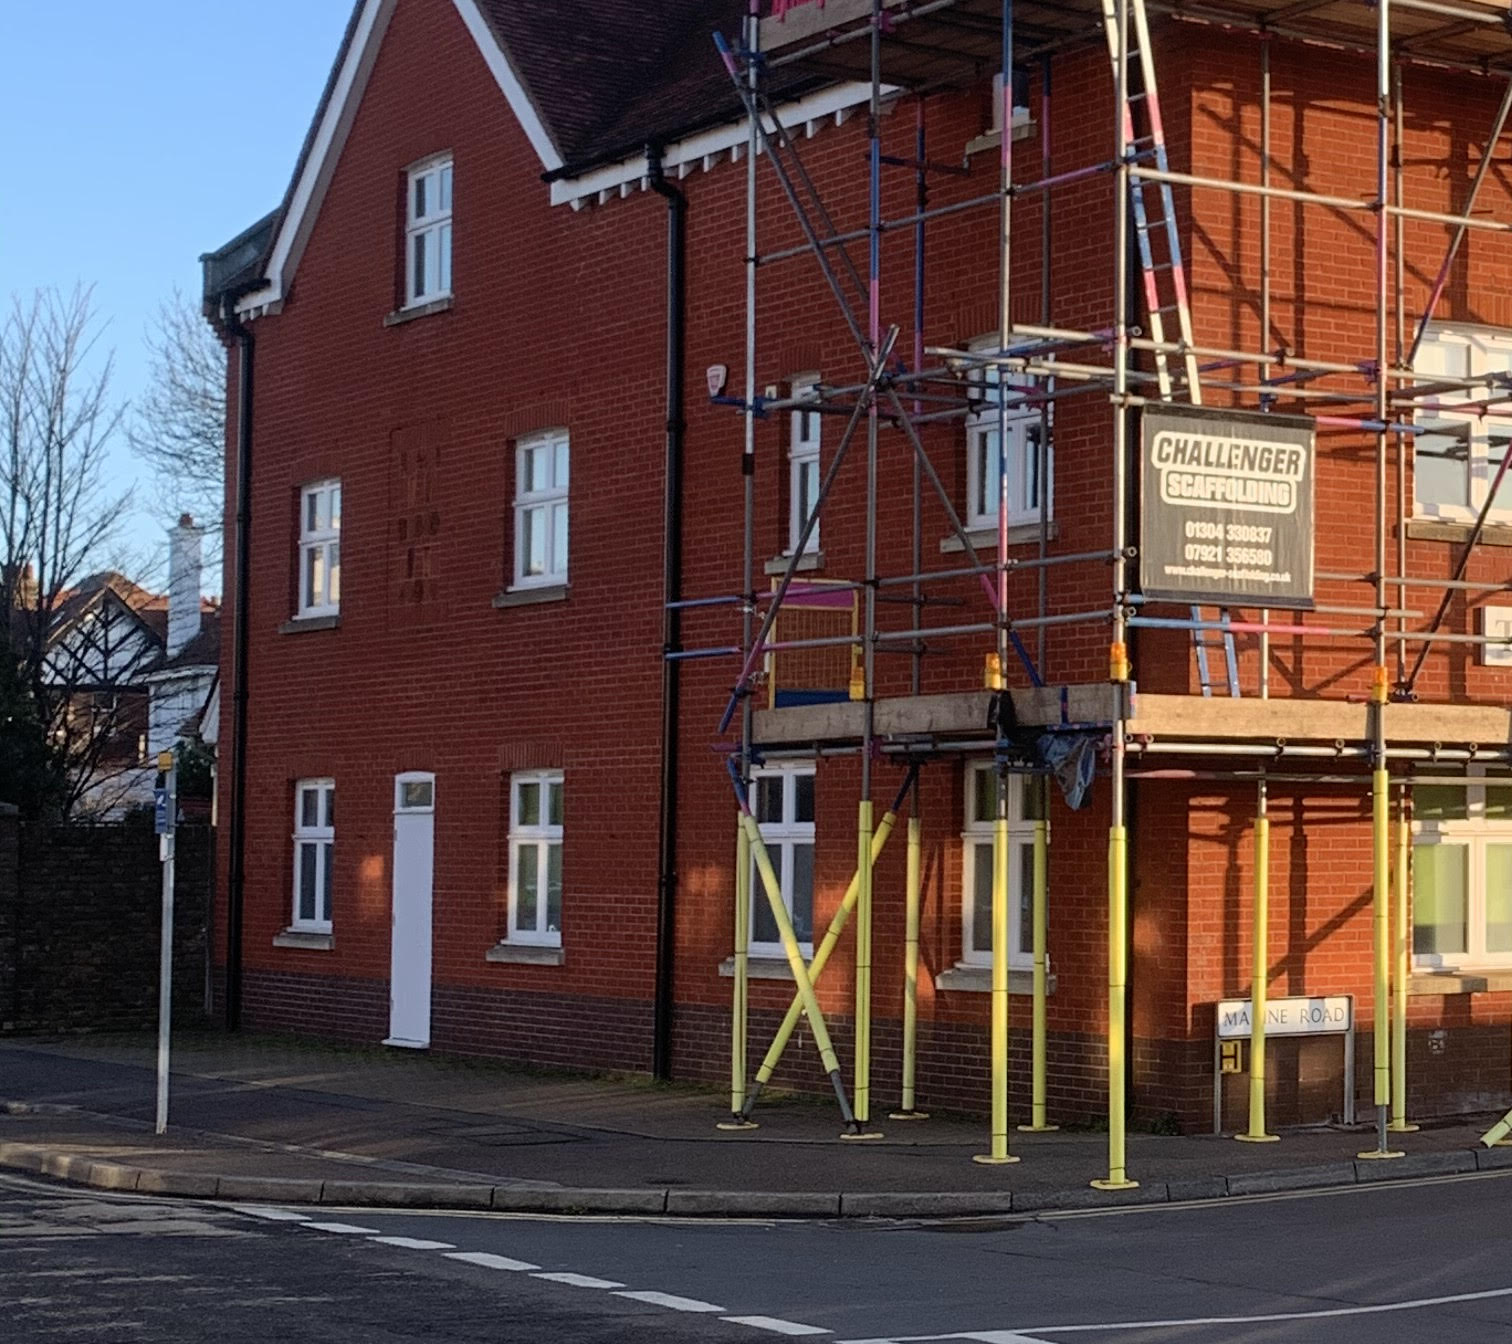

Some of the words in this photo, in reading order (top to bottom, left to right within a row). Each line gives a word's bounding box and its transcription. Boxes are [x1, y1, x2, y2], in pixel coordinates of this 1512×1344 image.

[1157, 437, 1301, 476] CHALLENGER
[1167, 473, 1290, 506] SCAFFOLDING
[1185, 521, 1224, 540] 01304
[1185, 544, 1222, 562] 07921
[1224, 1009, 1289, 1027] MAINE
[1300, 1007, 1345, 1024] ROAD
[1220, 1043, 1238, 1069] H
